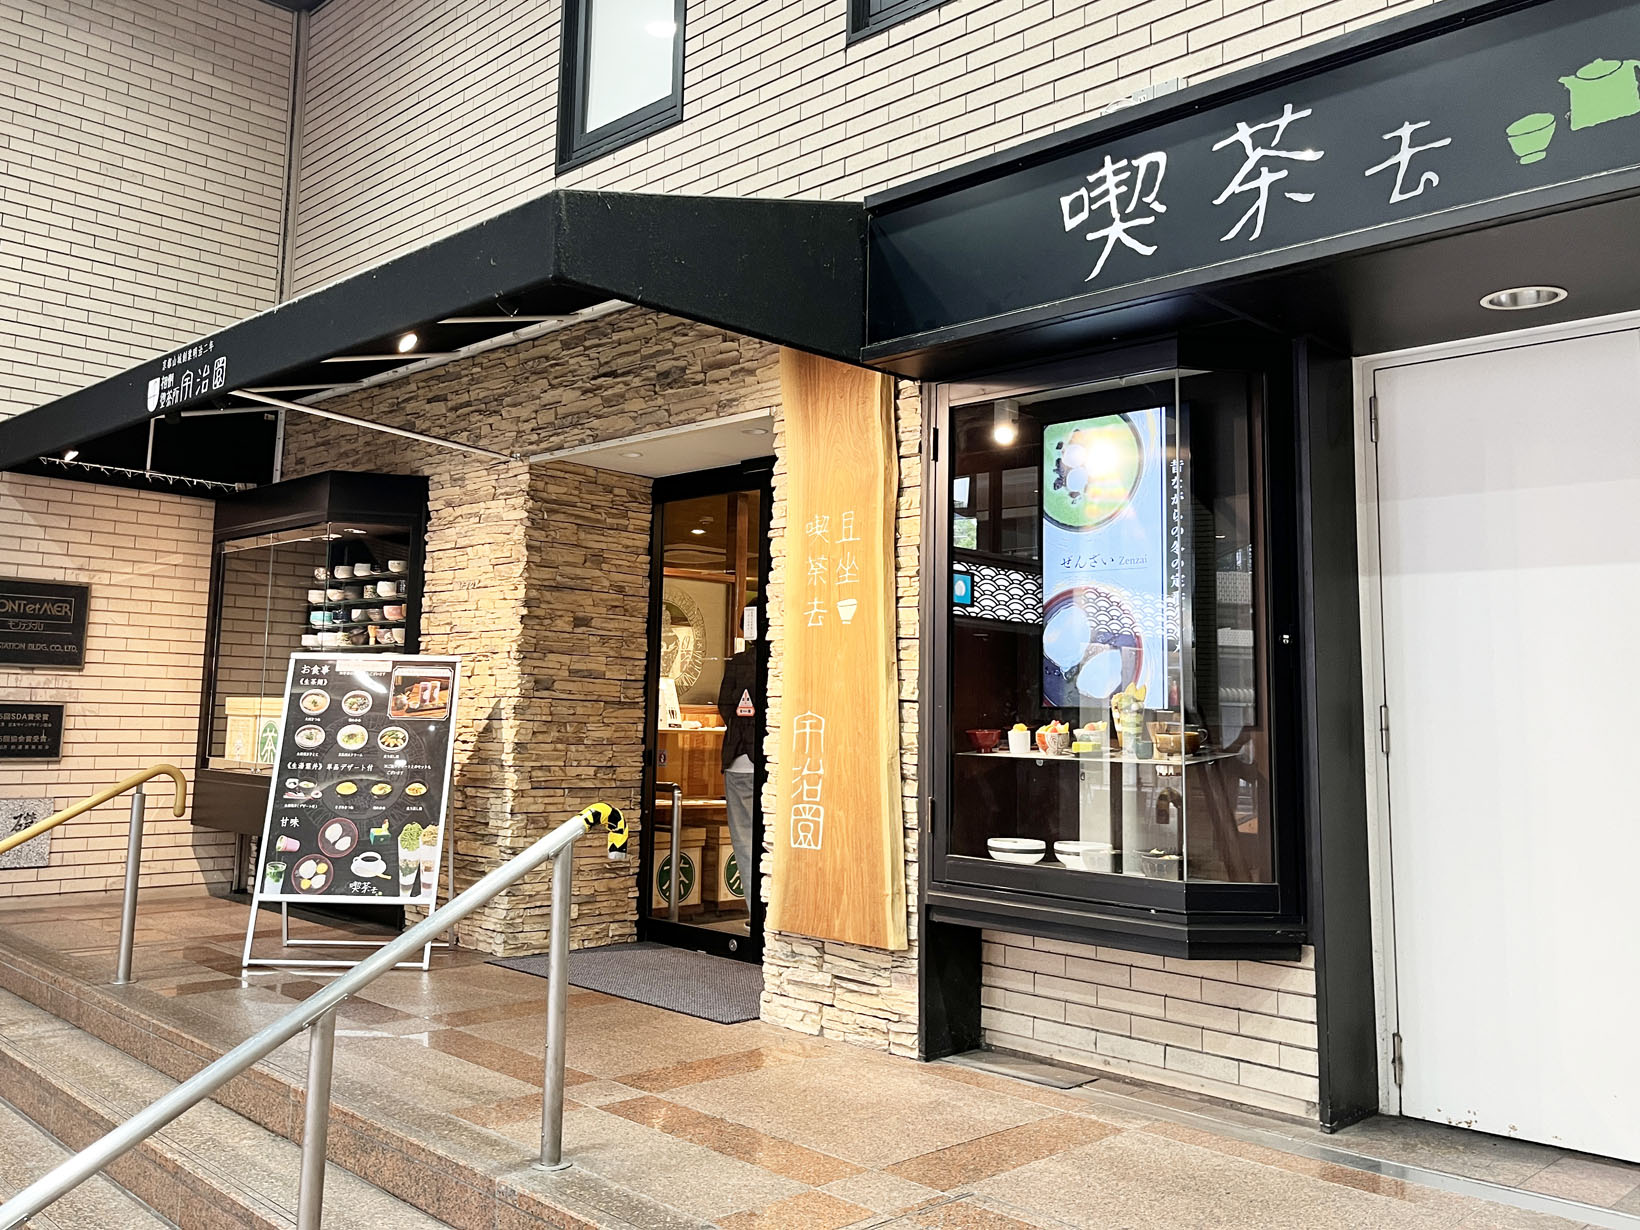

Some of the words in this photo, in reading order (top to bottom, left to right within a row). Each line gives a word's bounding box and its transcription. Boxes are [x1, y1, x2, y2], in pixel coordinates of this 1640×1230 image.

[1059, 103, 1452, 282] 喫茶去
[1060, 554, 1115, 569] ぜんざい
[1118, 553, 1148, 566] Zenzai
[803, 513, 830, 627] 喫茶去
[300, 664, 331, 676] お食事
[280, 816, 300, 828] 甘味
